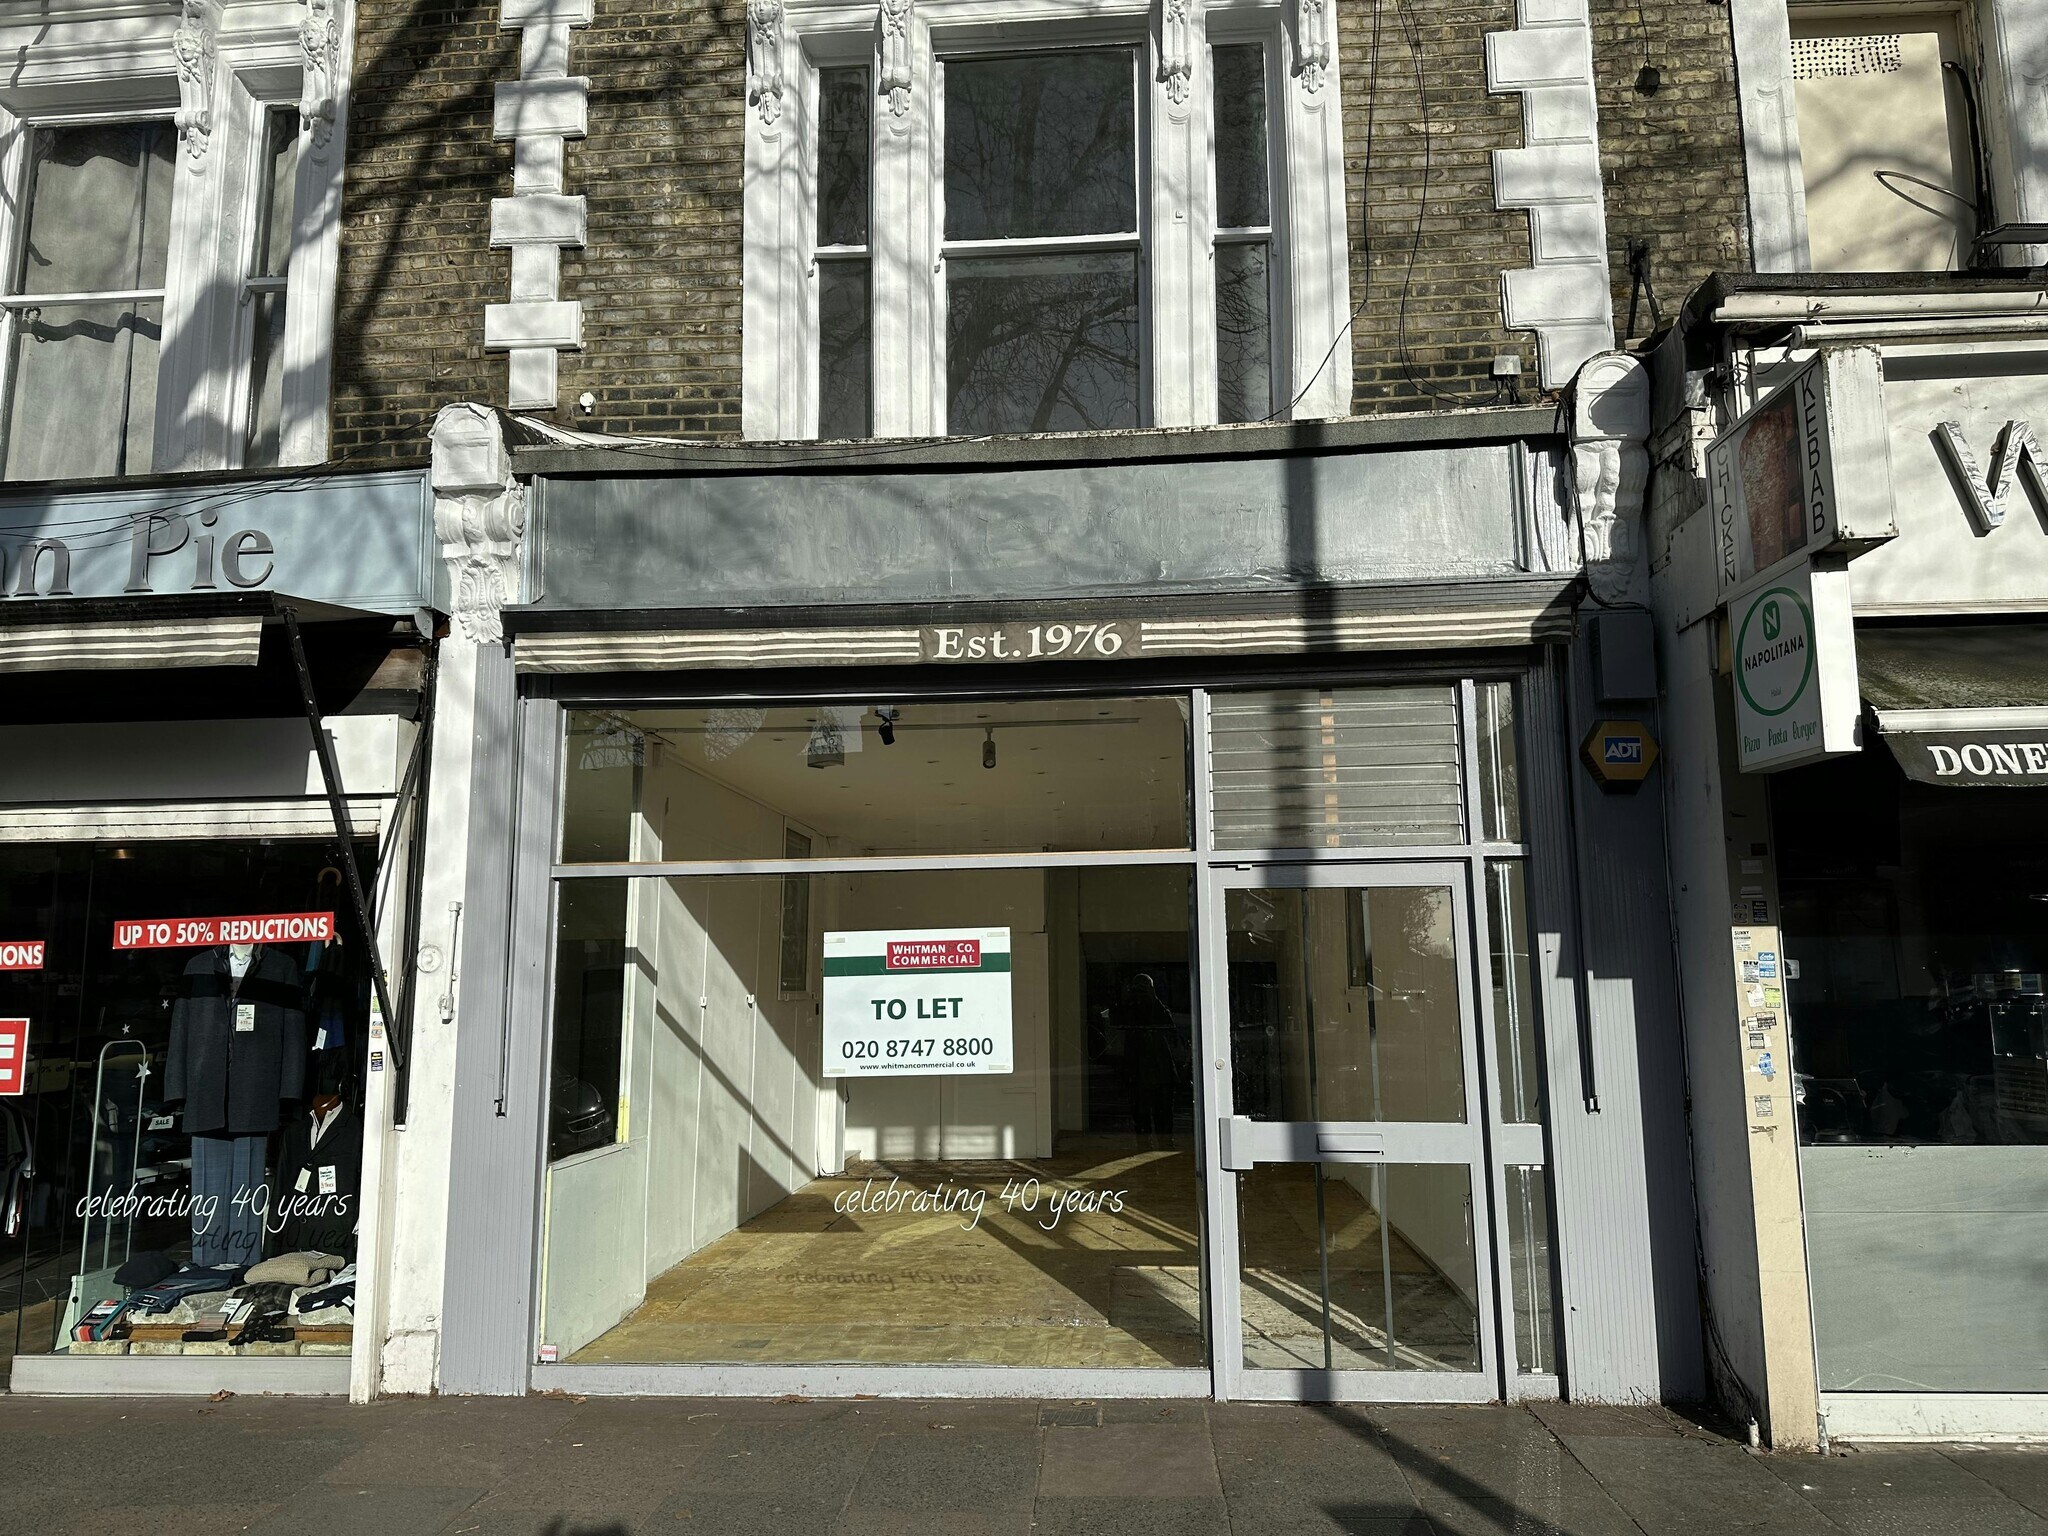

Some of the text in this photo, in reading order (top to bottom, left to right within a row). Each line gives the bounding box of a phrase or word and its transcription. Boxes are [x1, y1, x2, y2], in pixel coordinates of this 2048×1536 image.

[1801, 369, 1825, 535] KEBAB
[1716, 445, 1736, 587] CHICKEN
[0, 508, 275, 597] n Pie
[1744, 634, 1805, 672] NAPOLITANA
[1792, 720, 1817, 742] Burger
[1605, 742, 1641, 758] ADT
[1926, 743, 2048, 776] DONE
[119, 916, 329, 946] UP TO 50% REDUCTIONS
[892, 944, 946, 954] WHITMAN
[957, 942, 975, 953] CO.
[892, 955, 975, 966] COMMERCIAL
[871, 997, 963, 1020] TO LET
[842, 1037, 993, 1059] 020 8747 8800
[859, 1061, 976, 1070] www.whitmancommercial.couk
[155, 1118, 170, 1126] SALE
[75, 1183, 352, 1235] celebrating 40 years
[833, 1176, 1129, 1231] celebrating 40 years
